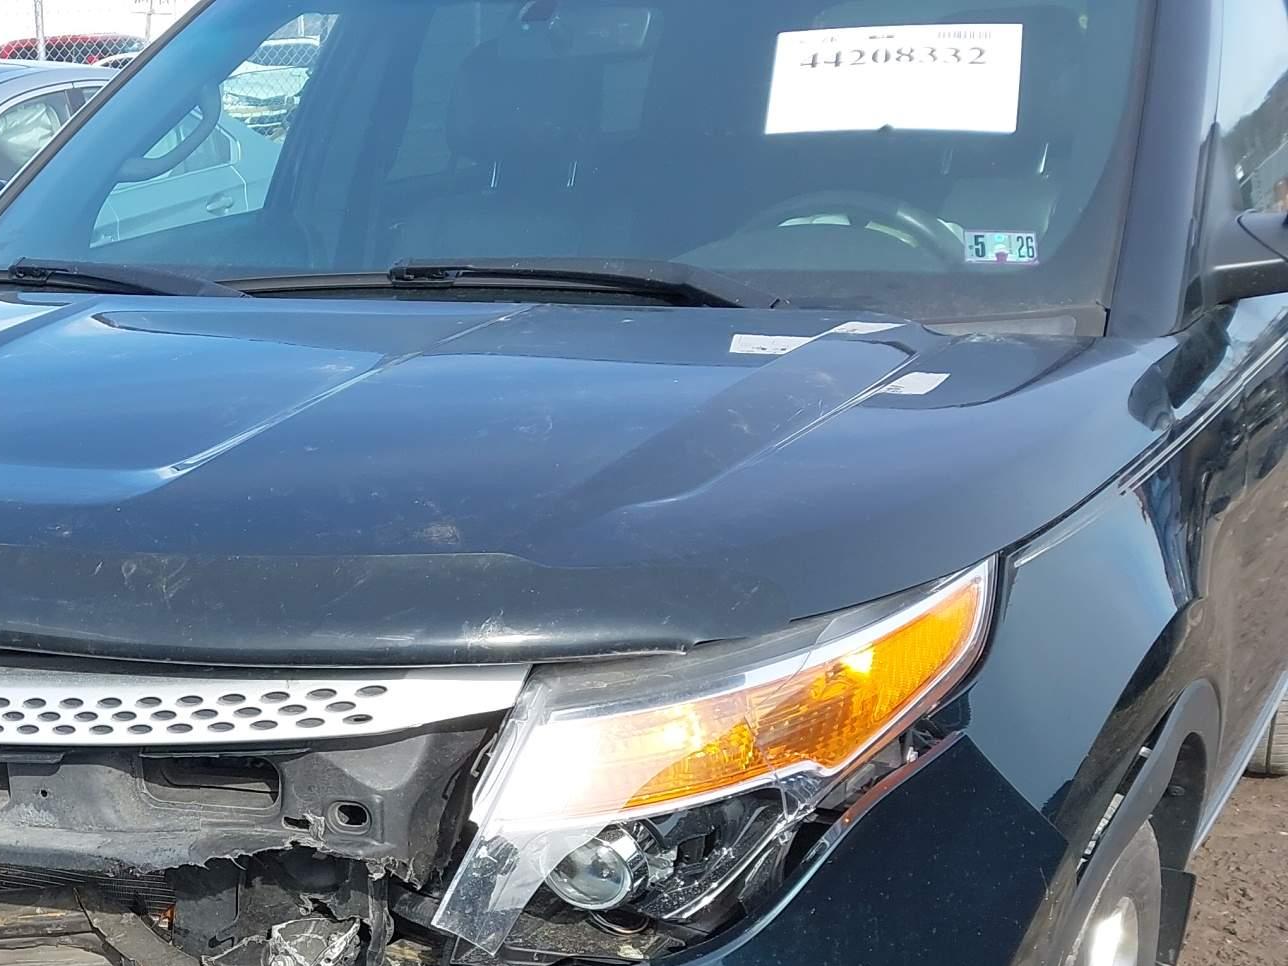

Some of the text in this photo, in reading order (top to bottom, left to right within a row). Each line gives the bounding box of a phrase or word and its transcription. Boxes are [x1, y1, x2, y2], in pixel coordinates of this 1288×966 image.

[800, 46, 987, 68] 44208332
[974, 234, 1035, 258] 5 26
